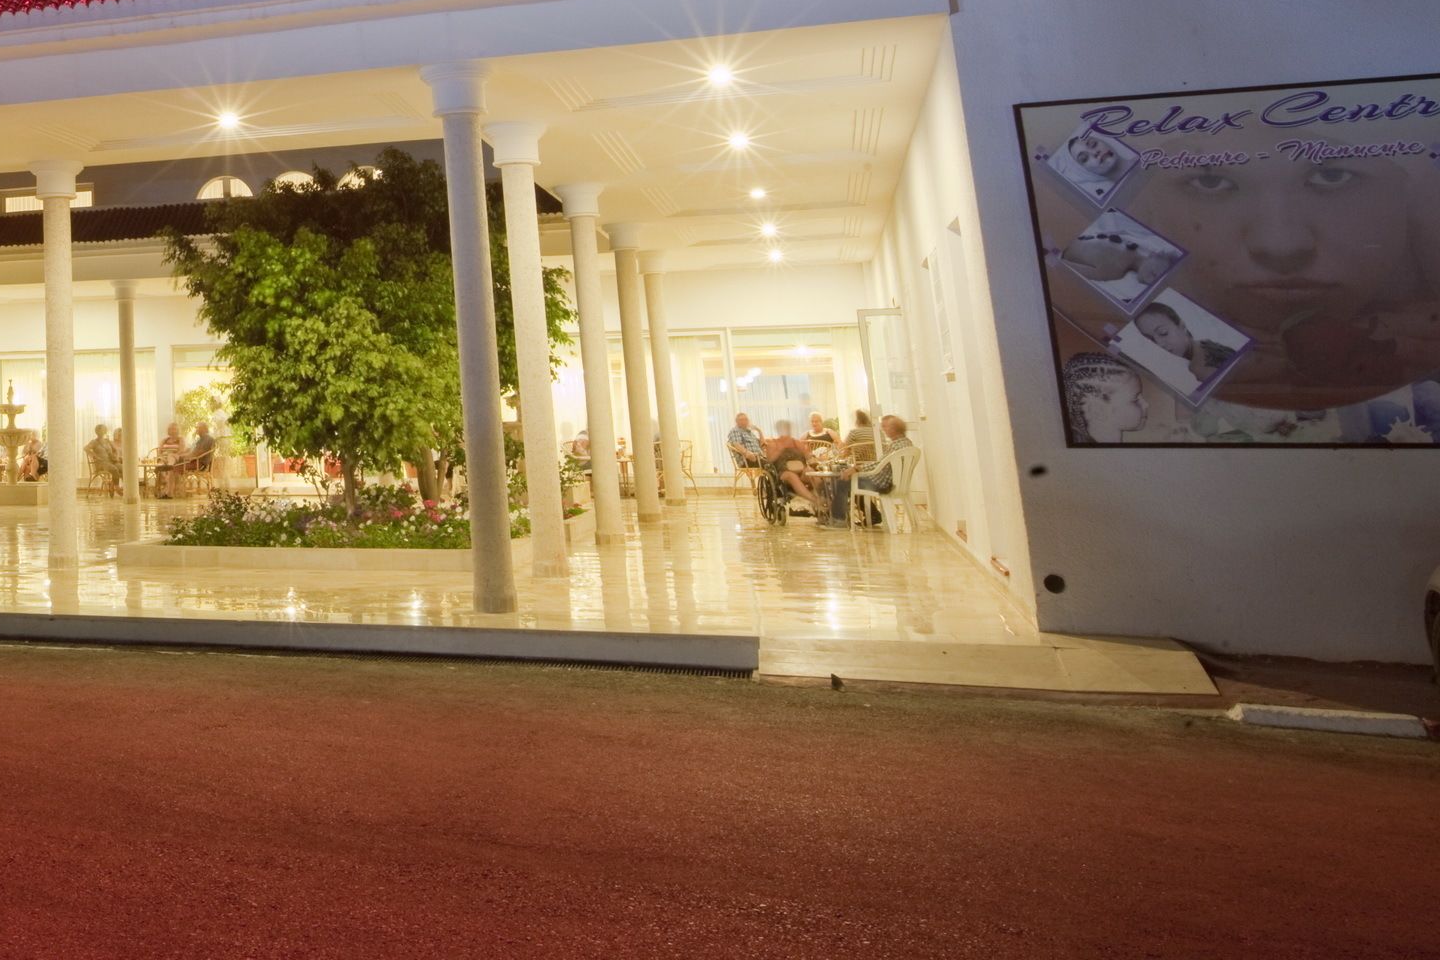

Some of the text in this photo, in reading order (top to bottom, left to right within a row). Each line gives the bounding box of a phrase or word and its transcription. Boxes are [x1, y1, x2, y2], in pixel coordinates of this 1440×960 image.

[1079, 90, 1440, 140] Relax Centr
[1276, 140, 1426, 166] Manucure
